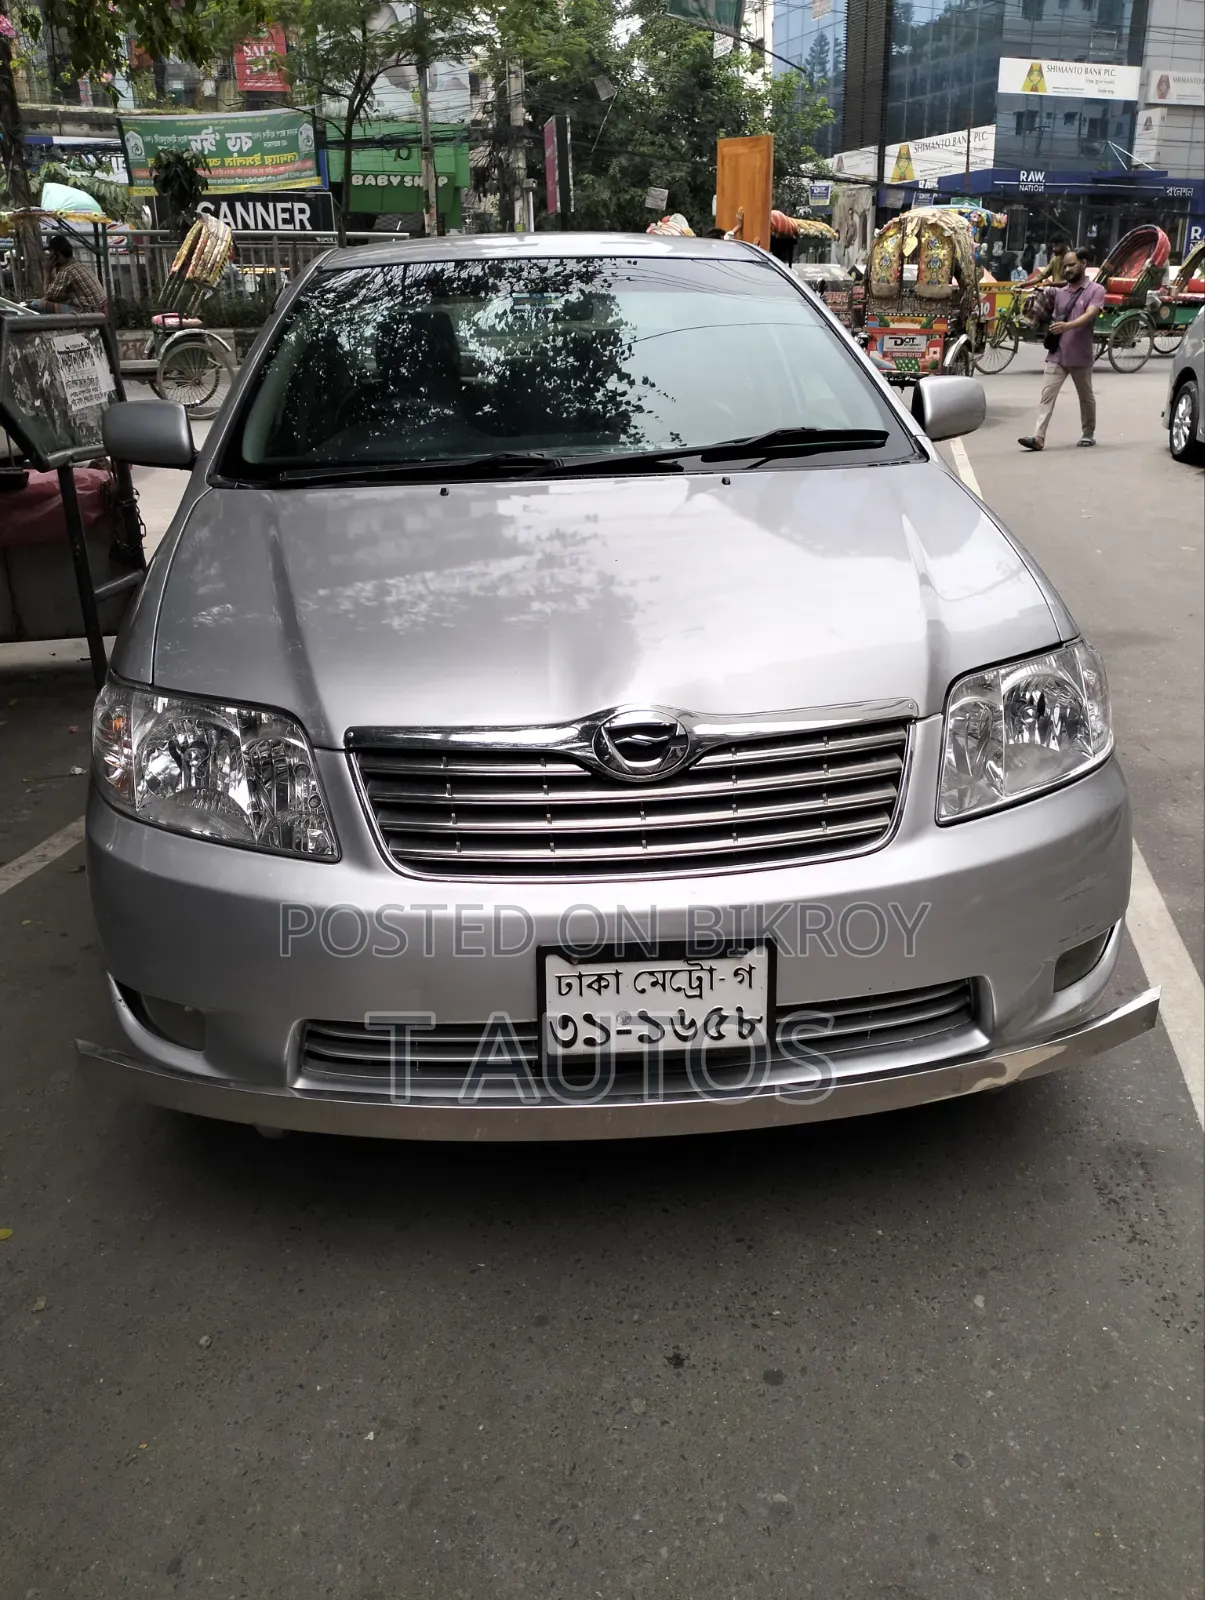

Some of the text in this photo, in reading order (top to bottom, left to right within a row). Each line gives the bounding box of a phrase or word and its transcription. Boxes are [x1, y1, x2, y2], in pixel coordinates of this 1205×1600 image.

[1046, 64, 1117, 77] SHIMANTO BANK PLC.
[914, 138, 950, 154] SHIMANTO
[351, 174, 449, 188] BABY SHP
[1018, 184, 1045, 192] NATION
[555, 969, 623, 998] ঢাকা
[550, 1005, 763, 1049] ৩১-১৬৫৮
